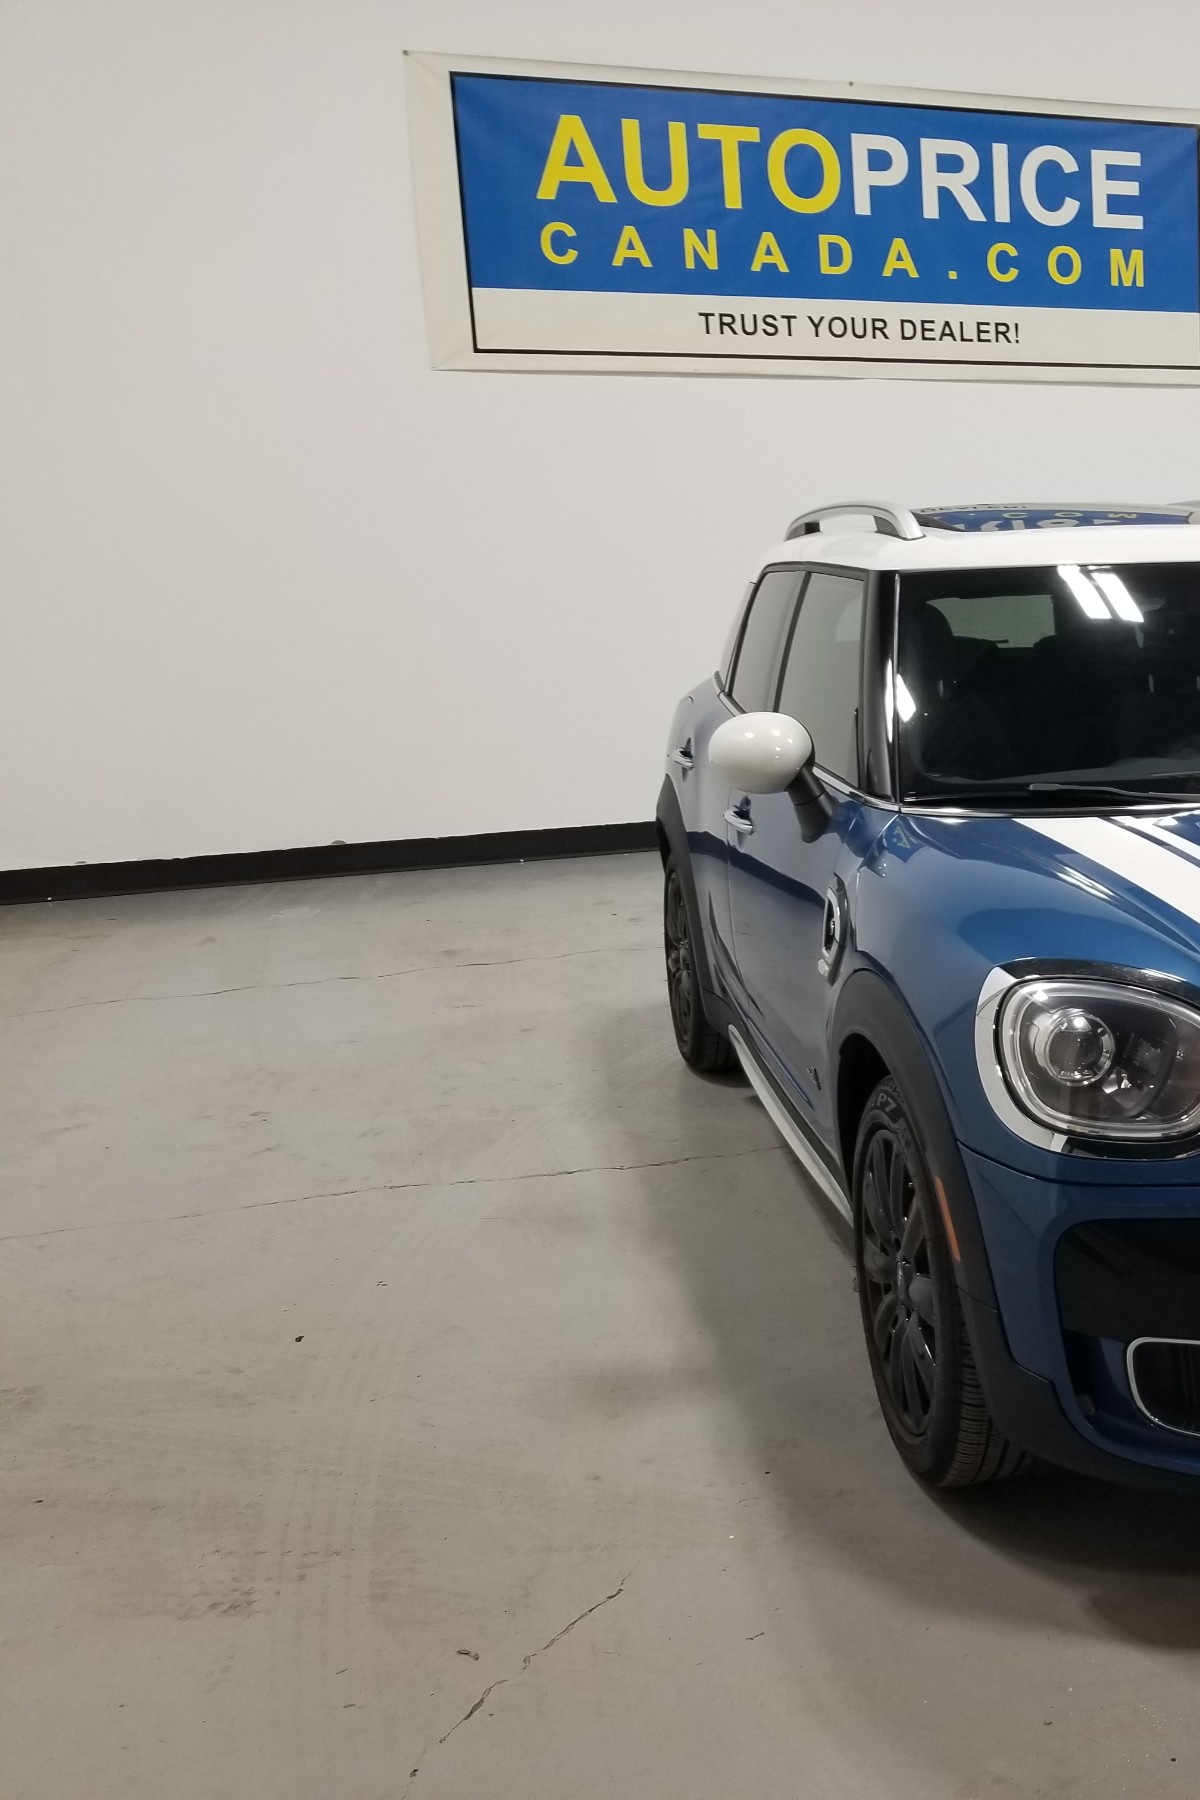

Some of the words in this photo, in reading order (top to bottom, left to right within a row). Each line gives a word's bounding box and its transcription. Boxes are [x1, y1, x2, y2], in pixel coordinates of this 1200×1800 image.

[535, 113, 1145, 230] AUTOPRICE
[540, 220, 1146, 288] CANADA.COM
[699, 312, 798, 337] TRUST
[807, 315, 890, 340] YOUR
[900, 318, 1020, 344] DEALER!
